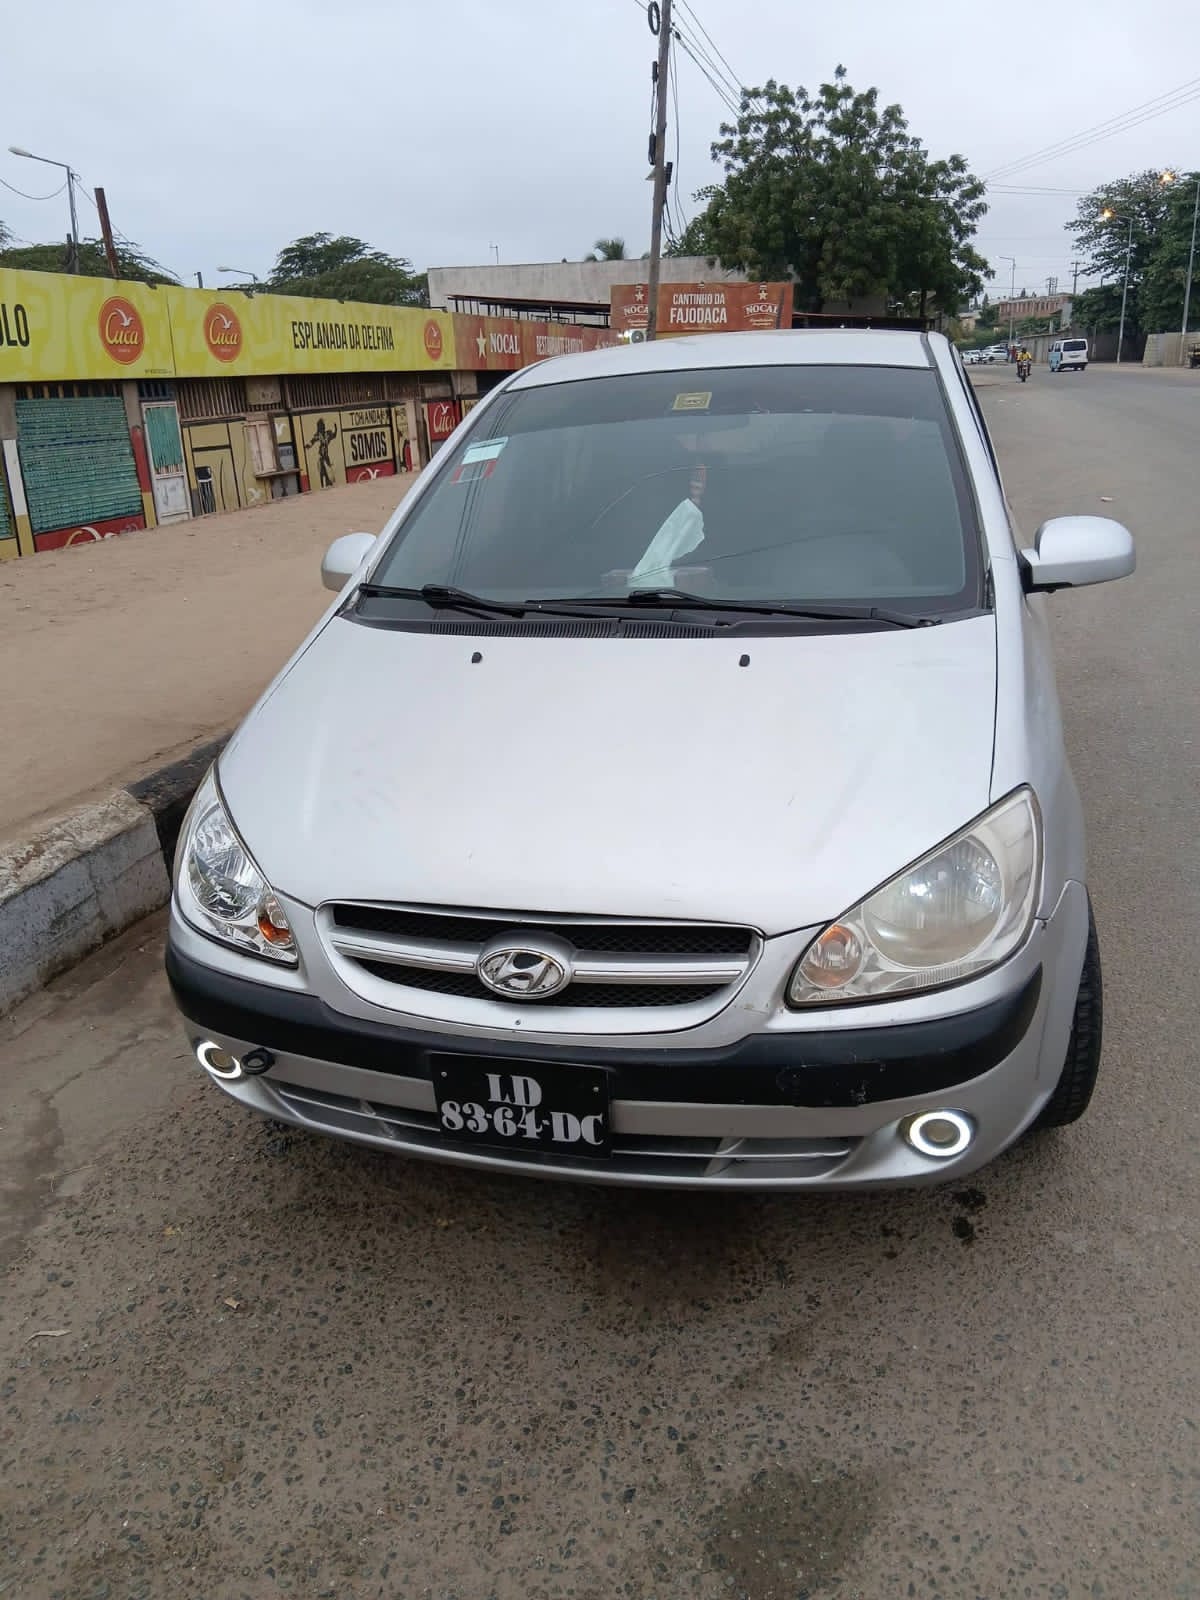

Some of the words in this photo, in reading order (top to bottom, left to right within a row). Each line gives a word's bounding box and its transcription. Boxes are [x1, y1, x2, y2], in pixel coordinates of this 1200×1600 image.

[624, 305, 649, 316] NOCA
[673, 293, 714, 304] CANTINHO
[715, 293, 725, 304] DA
[746, 303, 779, 315] NOCAL
[0, 304, 30, 347] LO
[106, 312, 139, 346] Cuca
[209, 315, 239, 346] Cuca
[670, 307, 728, 324] FAJODACA
[293, 321, 347, 350] ESPLANADA
[348, 325, 361, 350] DA
[363, 325, 394, 351] DELFINA
[490, 333, 520, 355] NOCAL
[433, 405, 456, 433] Cuca
[350, 432, 387, 462] SOMOS
[485, 1073, 543, 1107] LD
[440, 1101, 604, 1145] 83-64-DC
